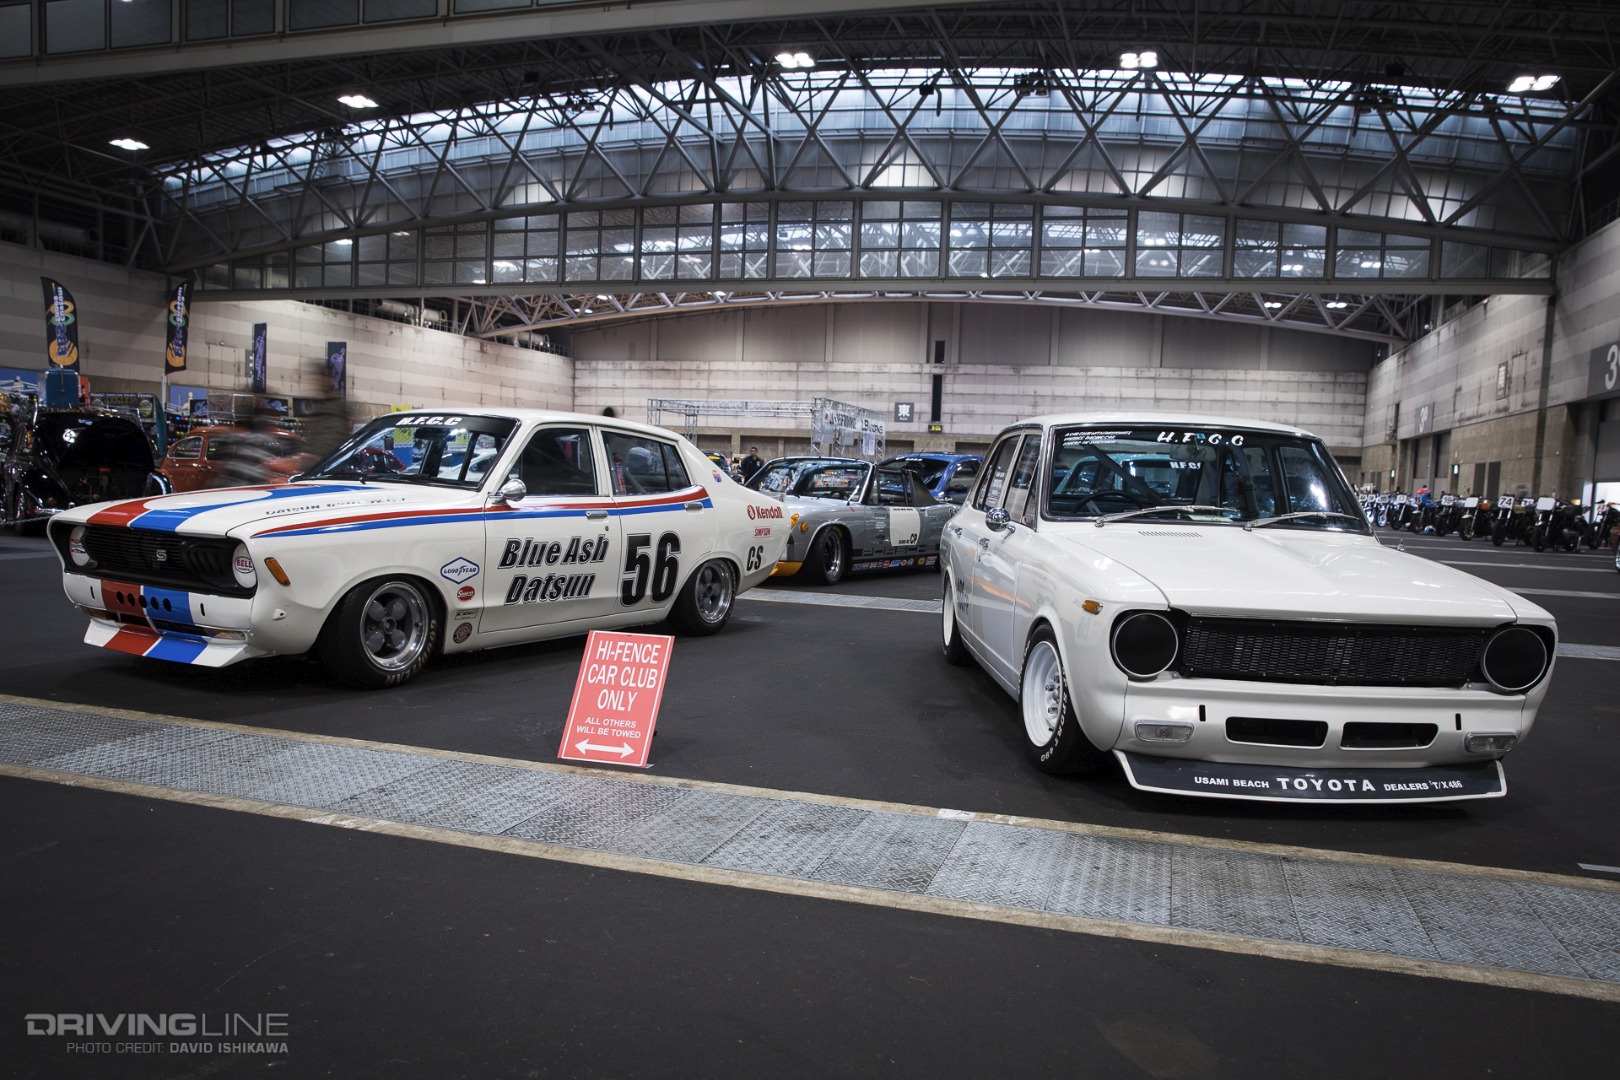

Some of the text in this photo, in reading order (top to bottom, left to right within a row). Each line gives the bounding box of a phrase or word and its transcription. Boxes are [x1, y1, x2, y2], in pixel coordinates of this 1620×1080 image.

[1500, 497, 1513, 505] 74
[756, 506, 784, 519] Kendall
[498, 534, 610, 569] Blue Ash
[747, 545, 764, 571] CS
[237, 559, 253, 569] BELL
[620, 531, 682, 607] 56
[504, 573, 596, 606] Datsun
[596, 640, 661, 664] HI-FENCE
[587, 663, 658, 688] CAR CLUB
[597, 689, 638, 711] ONLY
[576, 725, 641, 739] WILL BE TOWED
[585, 717, 636, 728] ALL OTHERS
[1194, 776, 1229, 786] USAMI
[1233, 779, 1270, 788] BEACH
[1277, 777, 1376, 792] TOYOTA
[1384, 782, 1429, 792] DEALERS
